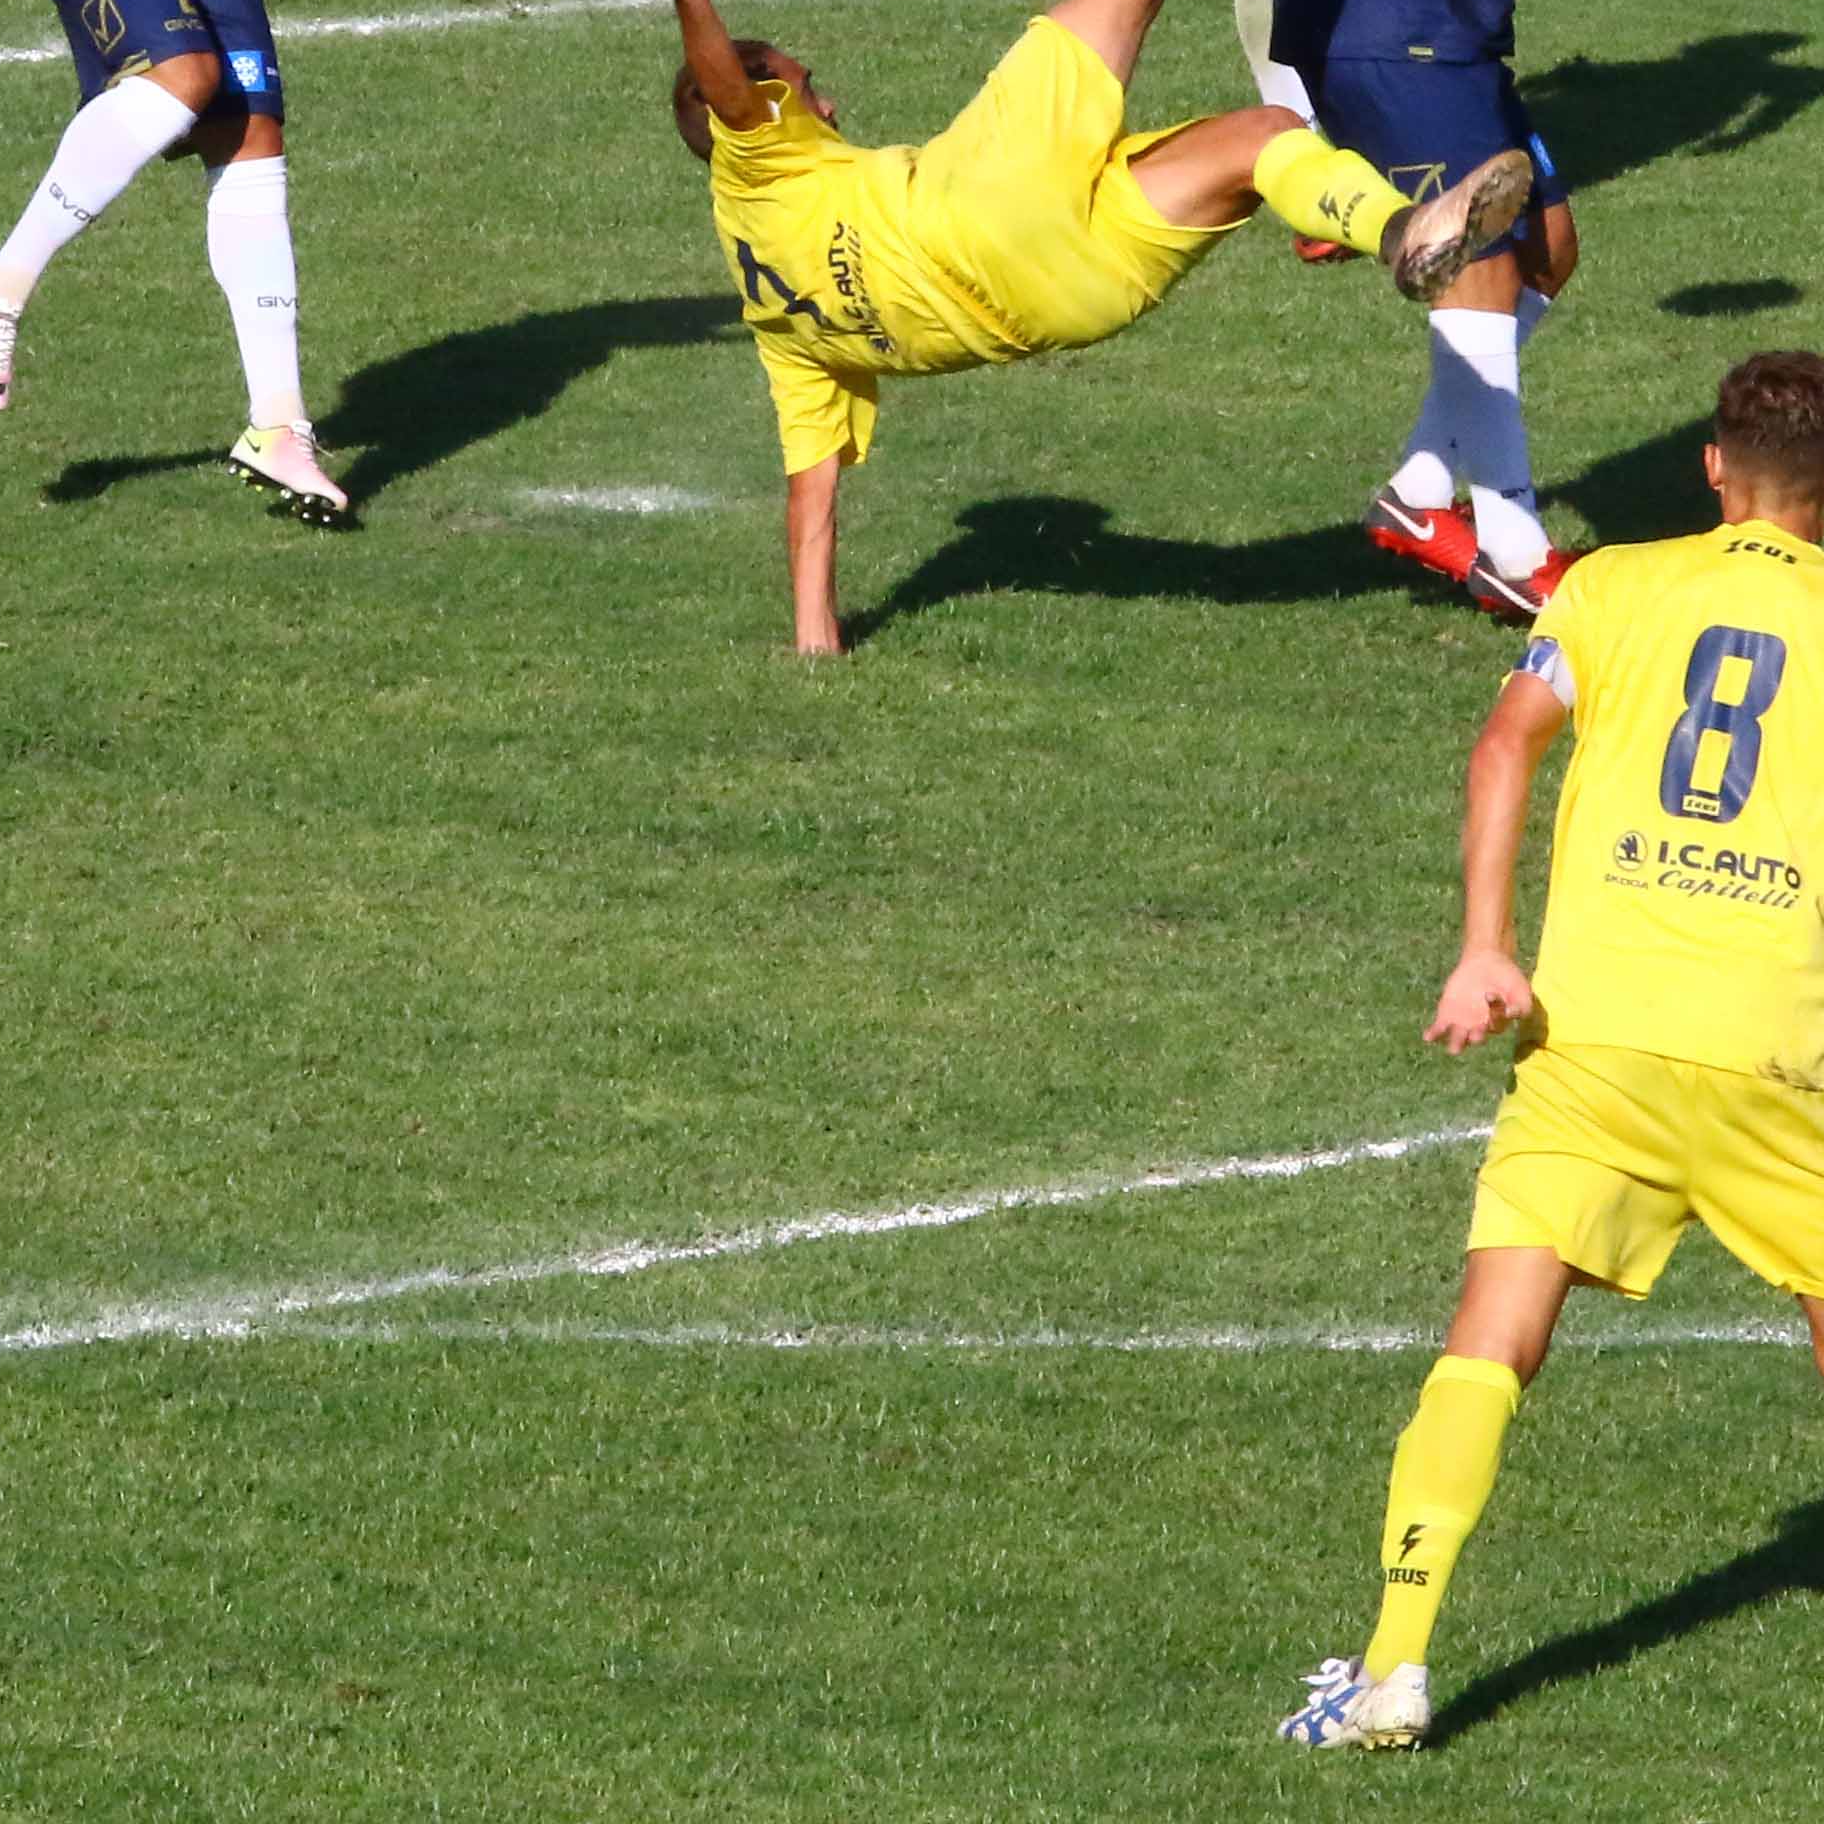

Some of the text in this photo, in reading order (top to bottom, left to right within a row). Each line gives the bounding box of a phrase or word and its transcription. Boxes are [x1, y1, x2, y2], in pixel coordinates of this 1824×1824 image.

[1659, 624, 1787, 824] 8
[1657, 840, 1802, 890] I.C.AUTO
[1657, 869, 1801, 909] Capitelli
